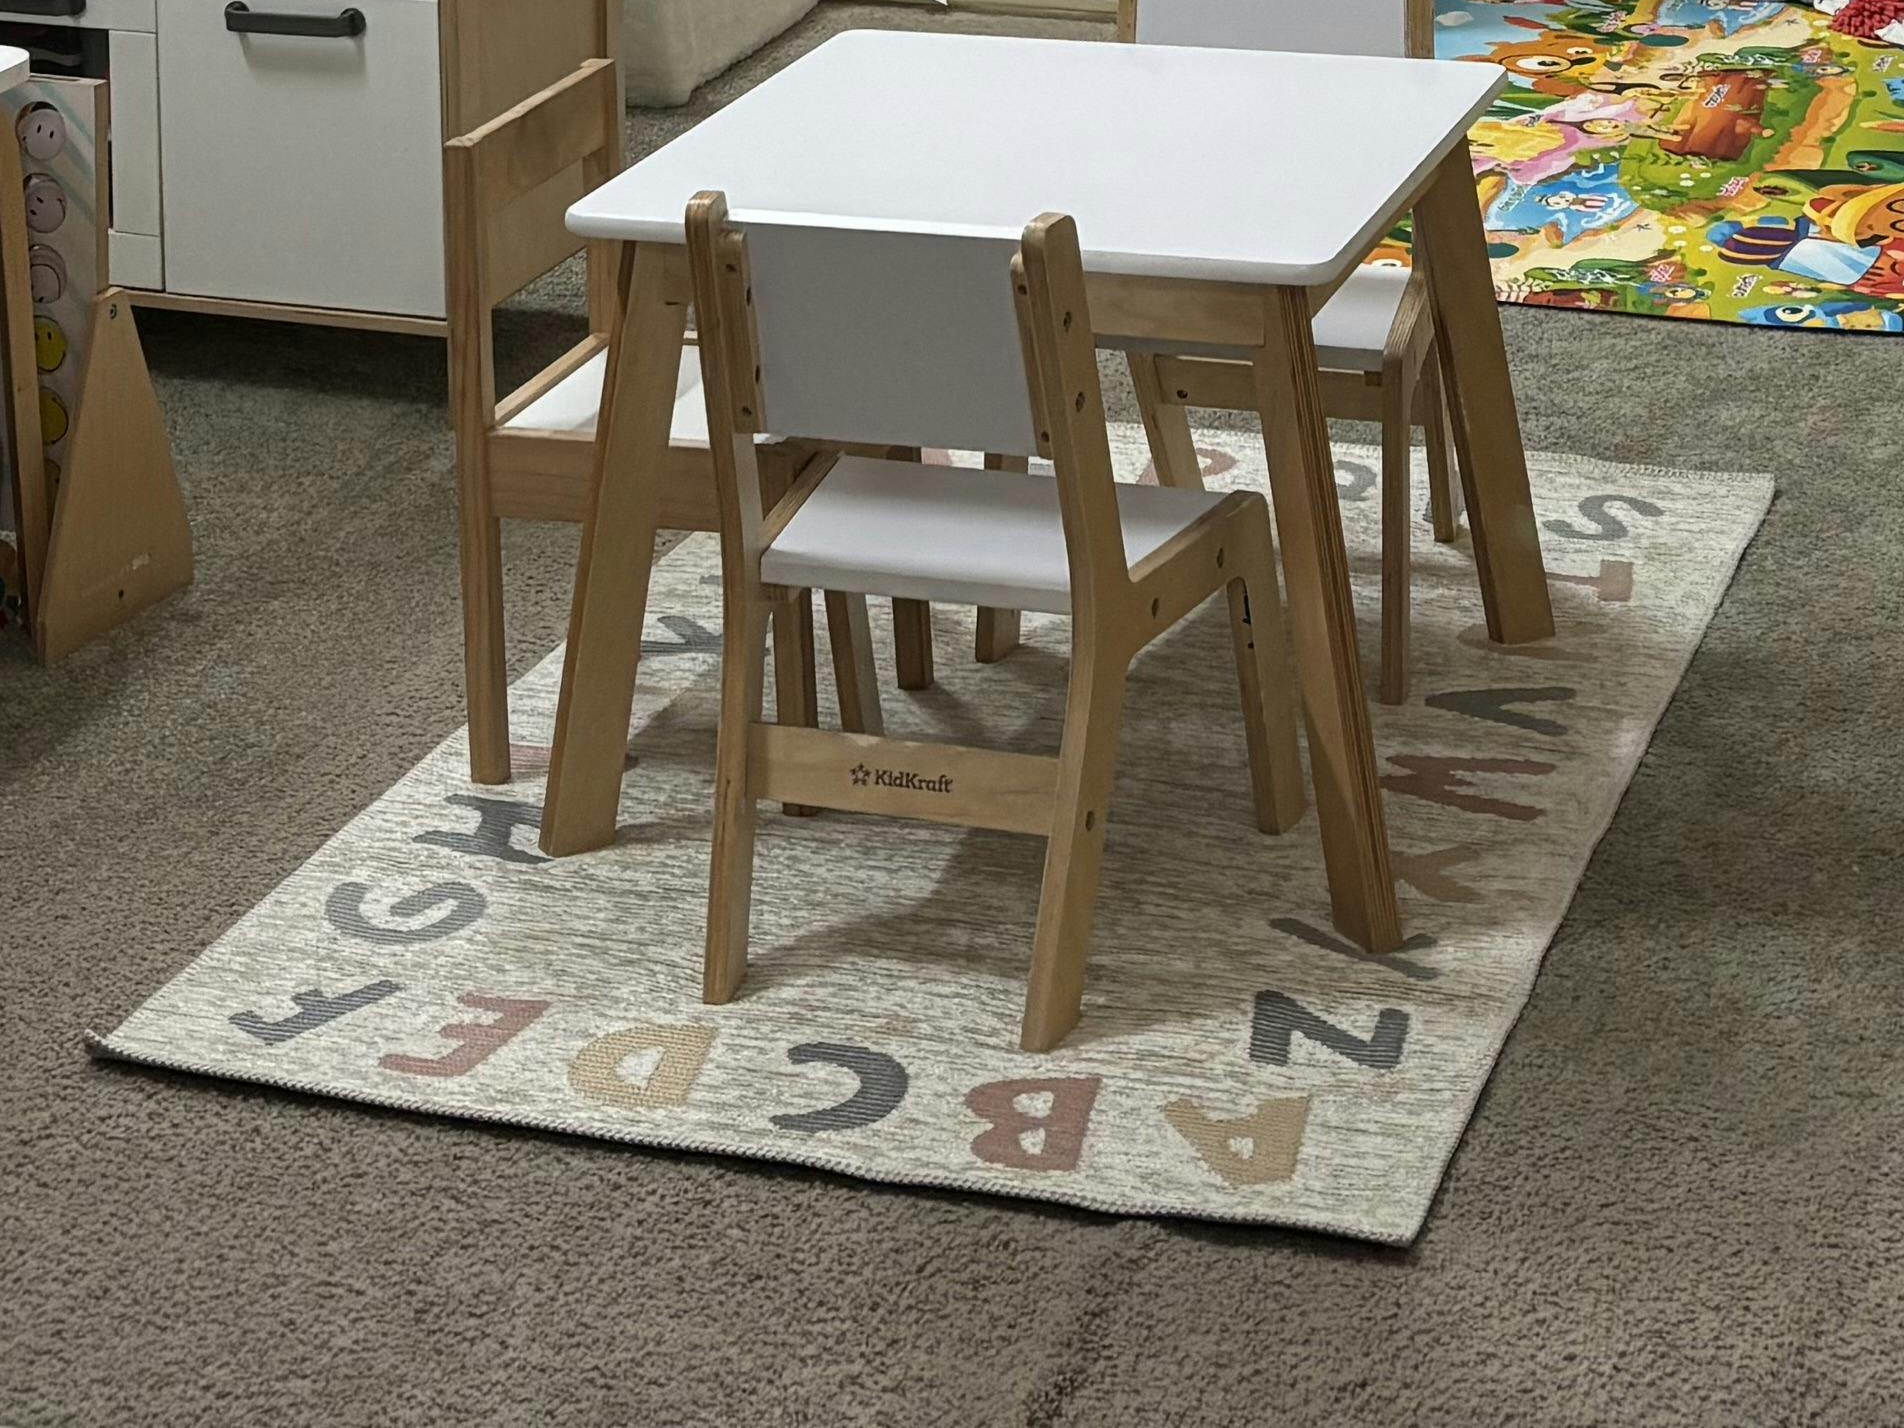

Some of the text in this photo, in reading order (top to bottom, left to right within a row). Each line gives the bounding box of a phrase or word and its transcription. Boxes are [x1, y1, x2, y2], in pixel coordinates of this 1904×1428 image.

[1543, 494, 1665, 542] S
[875, 769, 953, 793] KidKraft
[325, 882, 489, 944] G
[229, 980, 403, 1046] F
[378, 992, 557, 1077] E
[568, 1023, 720, 1107] D
[769, 1041, 909, 1134] C
[964, 1075, 1103, 1172] B
[1161, 1095, 1311, 1186] A
